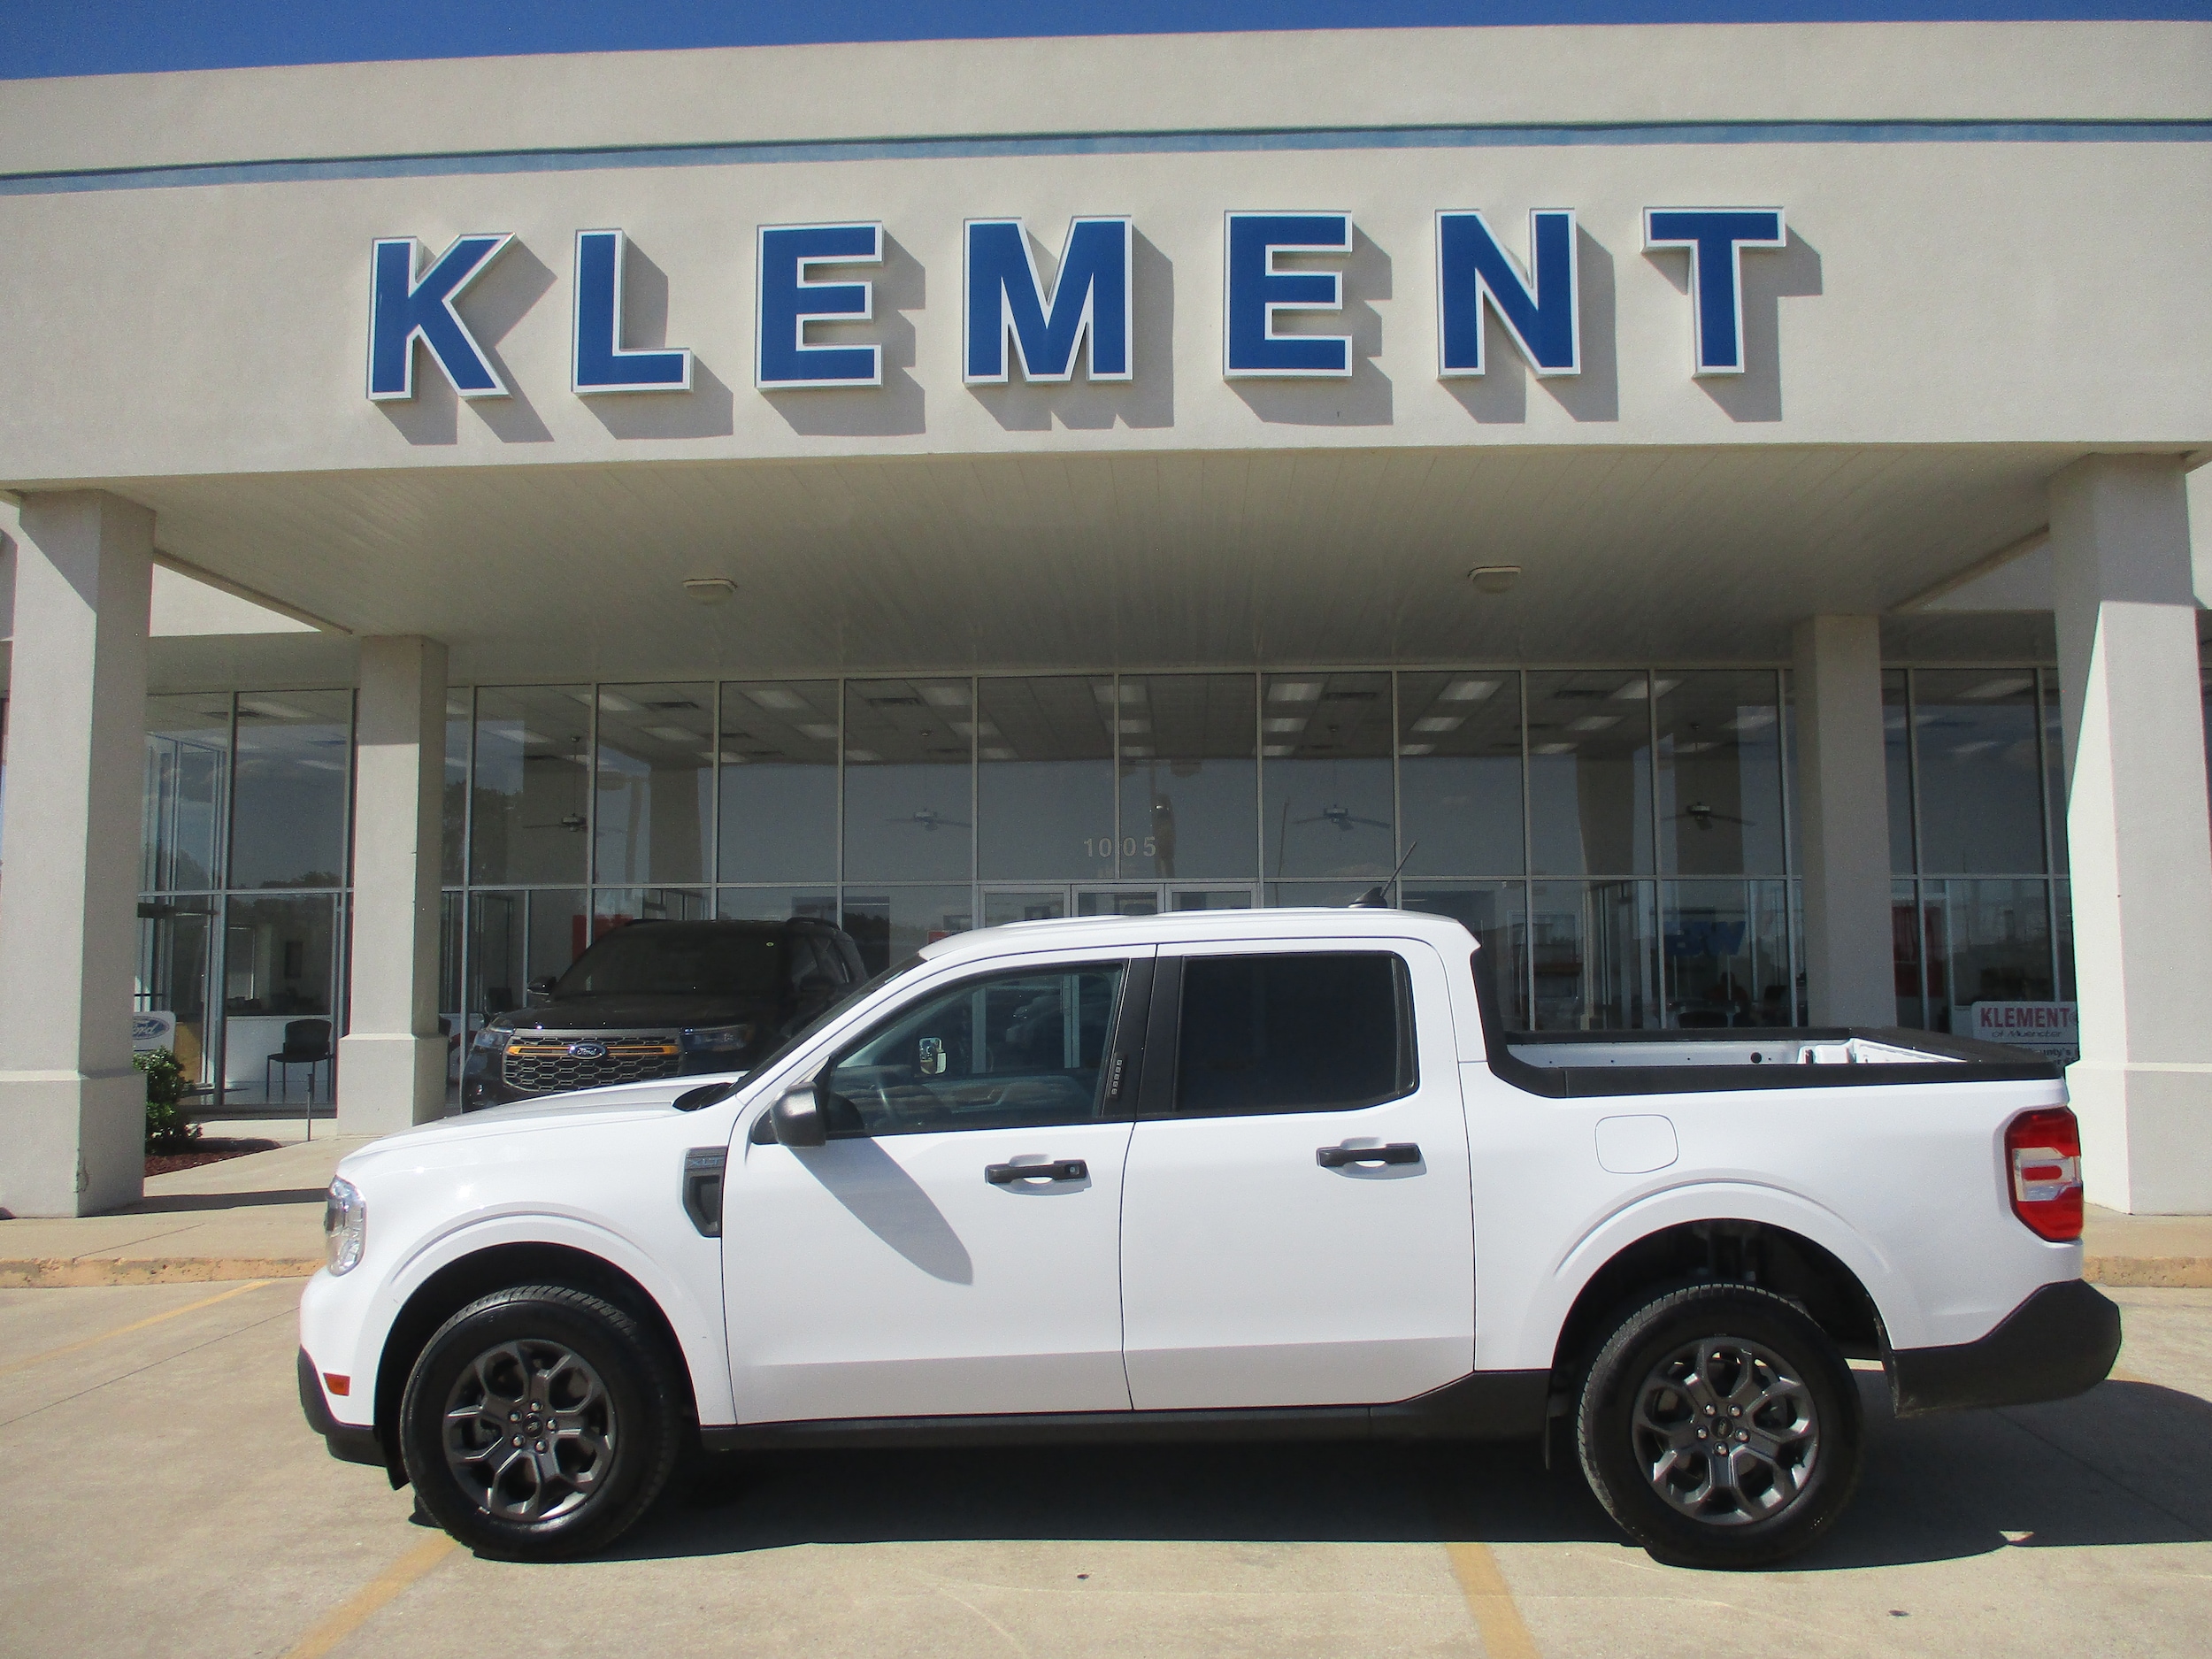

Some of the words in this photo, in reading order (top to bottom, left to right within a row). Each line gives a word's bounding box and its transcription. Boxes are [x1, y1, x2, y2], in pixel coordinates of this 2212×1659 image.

[367, 205, 1786, 402] KLEMENT
[1082, 836, 1156, 858] 1005
[1979, 1007, 2071, 1028] KLEMENT
[688, 1156, 725, 1167] XLT
